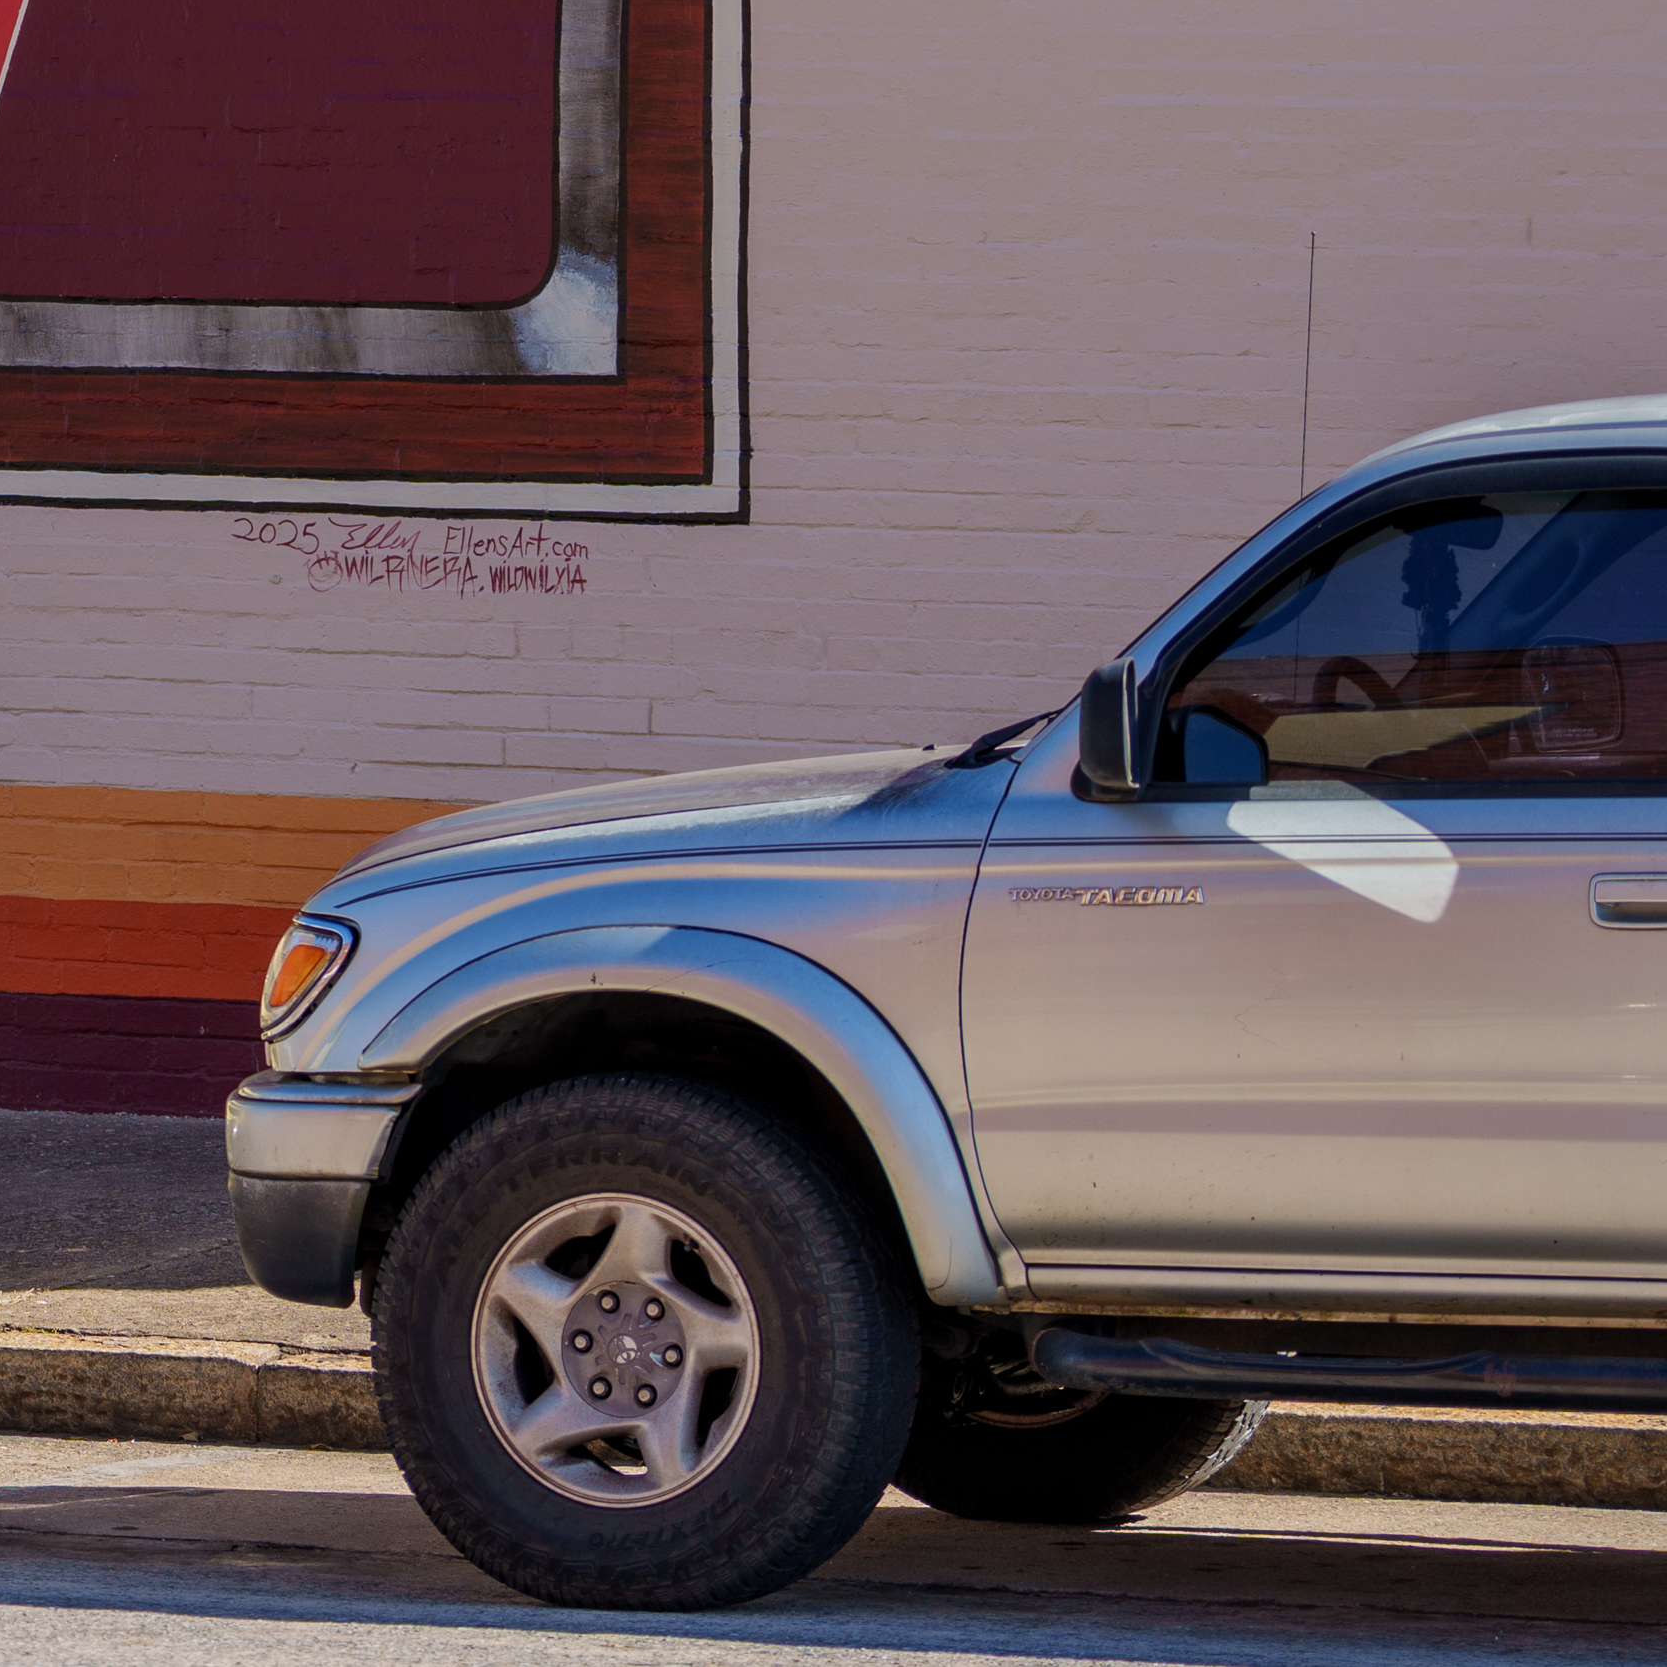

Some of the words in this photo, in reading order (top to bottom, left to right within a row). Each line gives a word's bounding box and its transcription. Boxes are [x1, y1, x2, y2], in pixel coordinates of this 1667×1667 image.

[231, 518, 319, 555] 2025
[1008, 887, 1075, 902] TOYOTA
[1075, 887, 1205, 905] TACOMA
